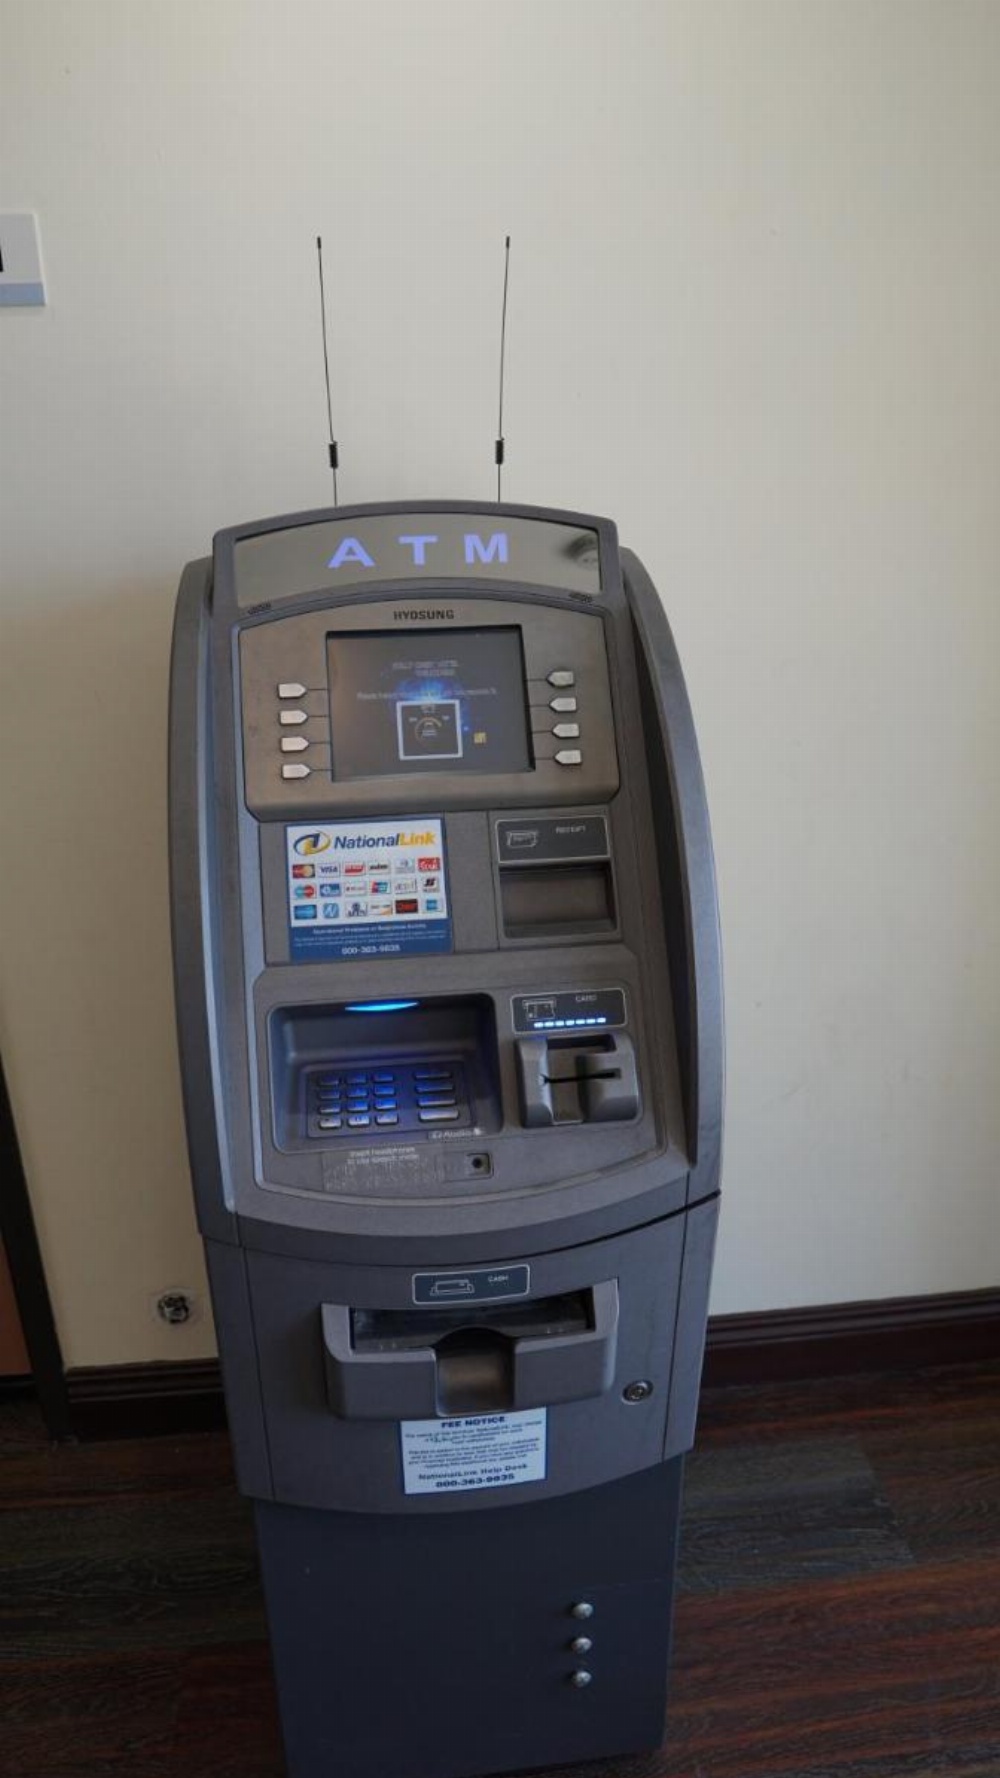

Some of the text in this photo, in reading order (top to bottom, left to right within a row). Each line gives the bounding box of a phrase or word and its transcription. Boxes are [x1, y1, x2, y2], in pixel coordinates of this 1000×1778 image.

[328, 533, 509, 568] ATM
[393, 609, 455, 621] HYOSUNG
[334, 831, 436, 850] NationalLink
[320, 865, 338, 873] VISA
[575, 994, 598, 1002] CARD
[441, 1416, 505, 1429] FEE NOTICE
